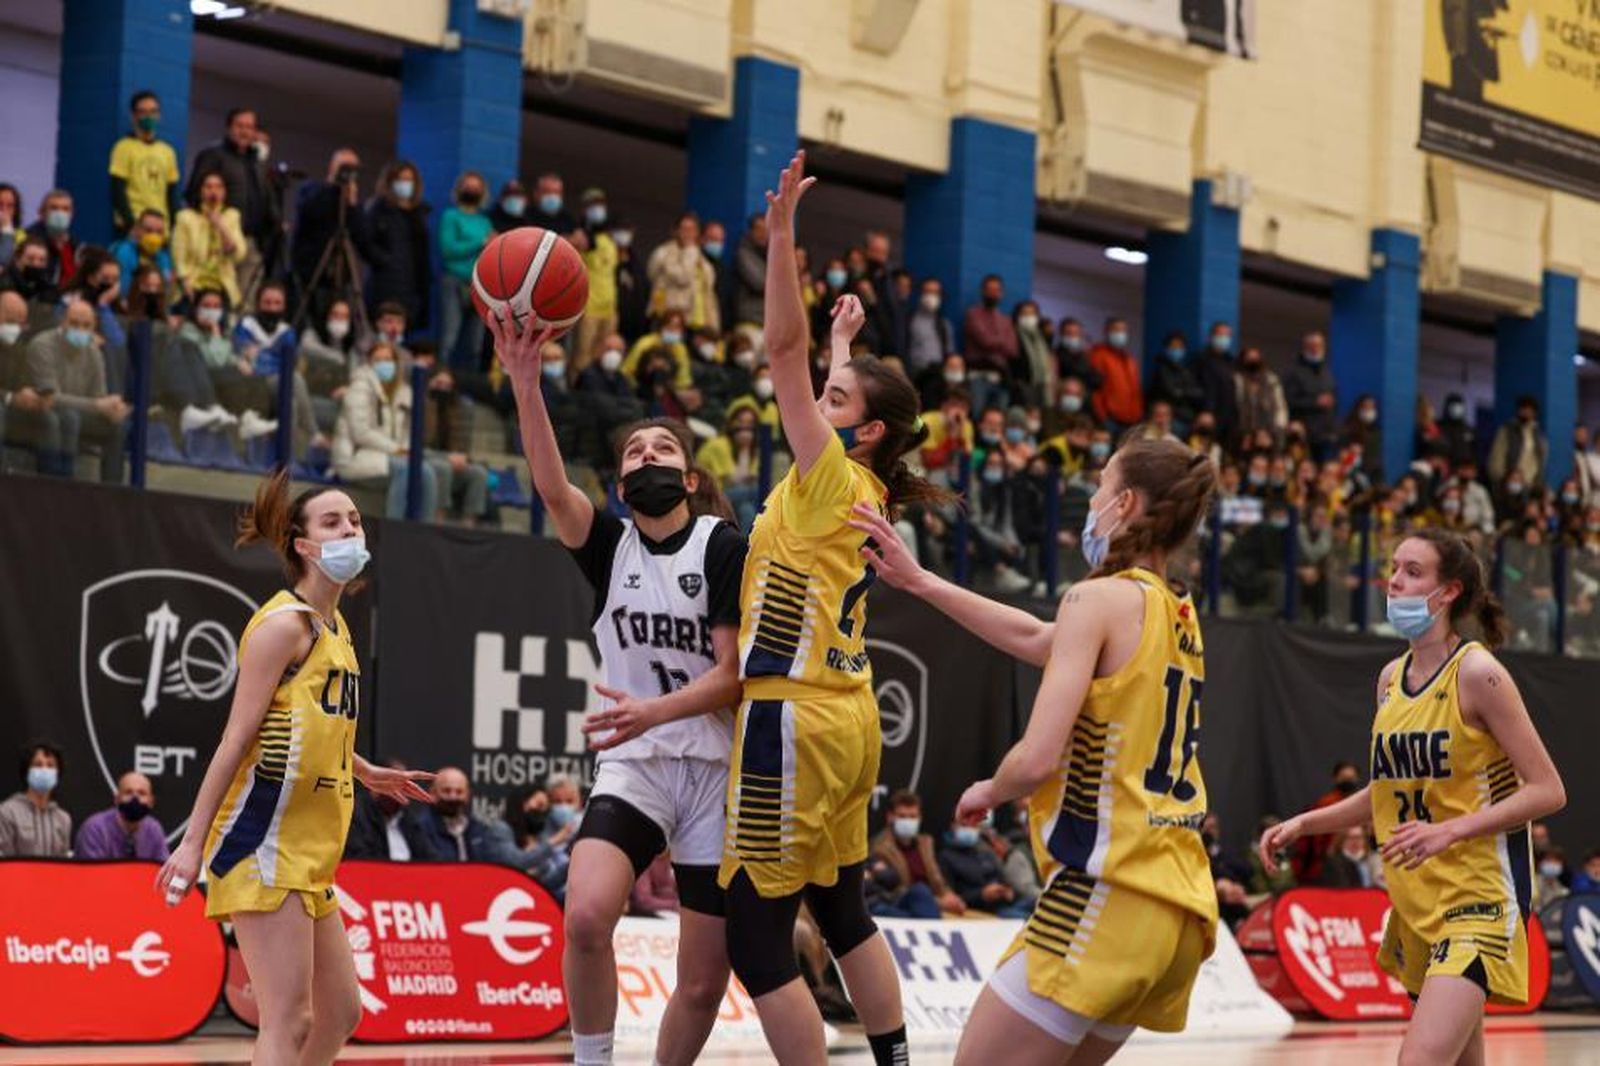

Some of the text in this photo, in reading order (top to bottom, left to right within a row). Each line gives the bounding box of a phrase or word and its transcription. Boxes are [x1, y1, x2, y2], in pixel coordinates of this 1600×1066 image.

[134, 745, 196, 777] BT
[371, 901, 448, 941] FBM
[5, 935, 111, 971] iberCaja
[386, 975, 459, 997] MADRID
[476, 980, 564, 1011] iberCaja
